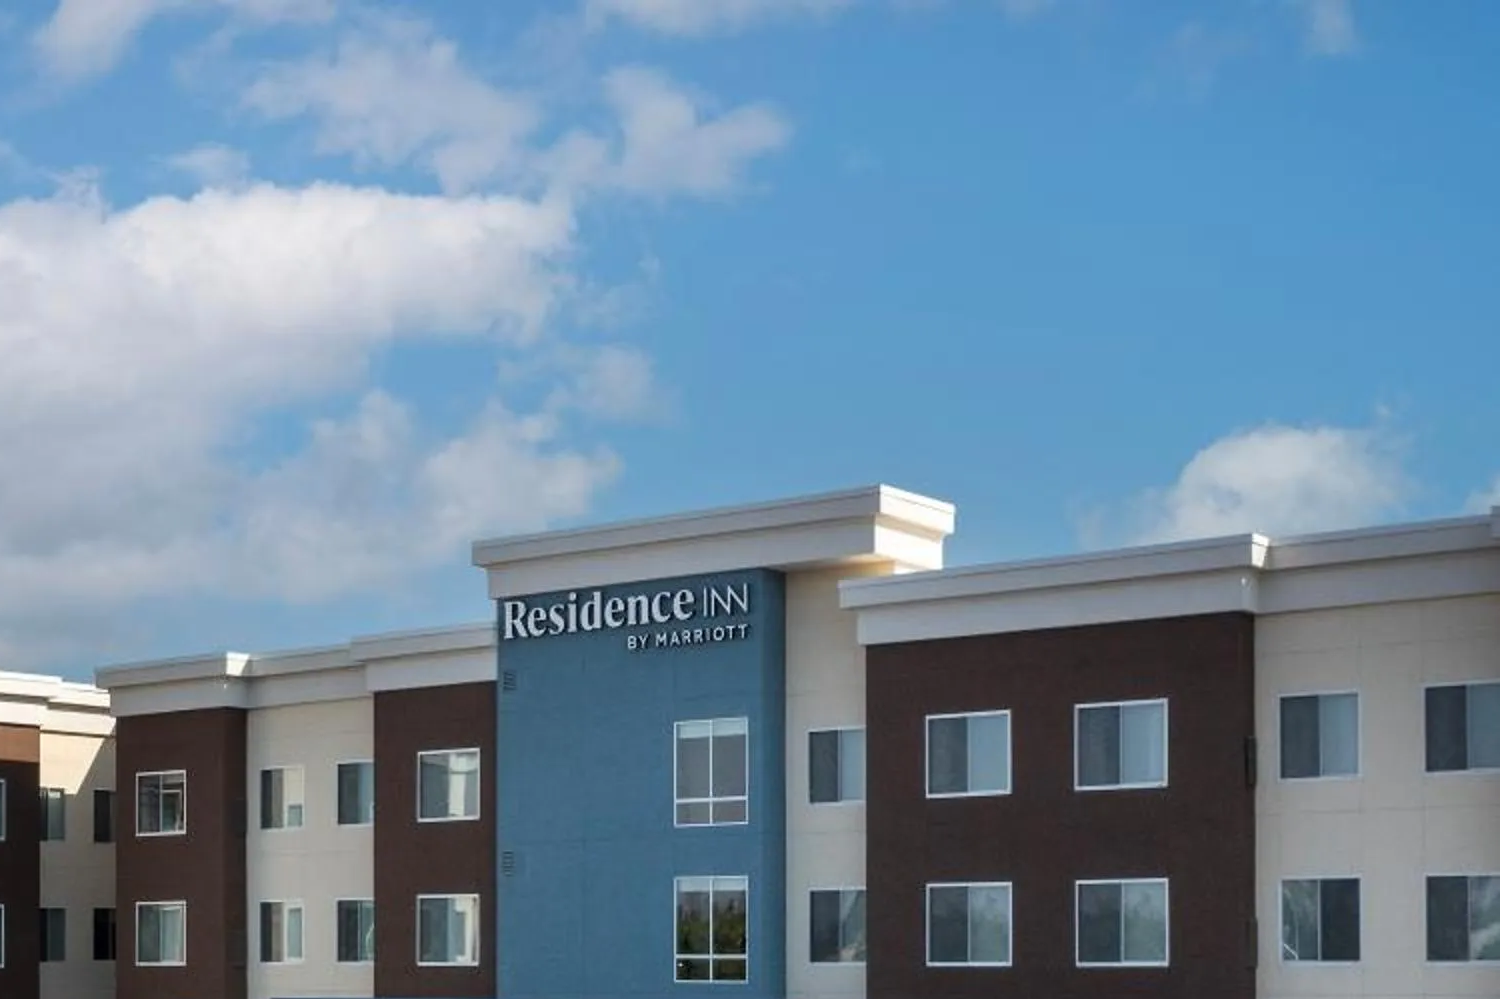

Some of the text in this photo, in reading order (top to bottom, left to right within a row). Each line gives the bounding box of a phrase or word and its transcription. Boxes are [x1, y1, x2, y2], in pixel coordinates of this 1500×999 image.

[503, 582, 749, 640] Residence INN
[627, 623, 748, 650] BY MARRIOTT
